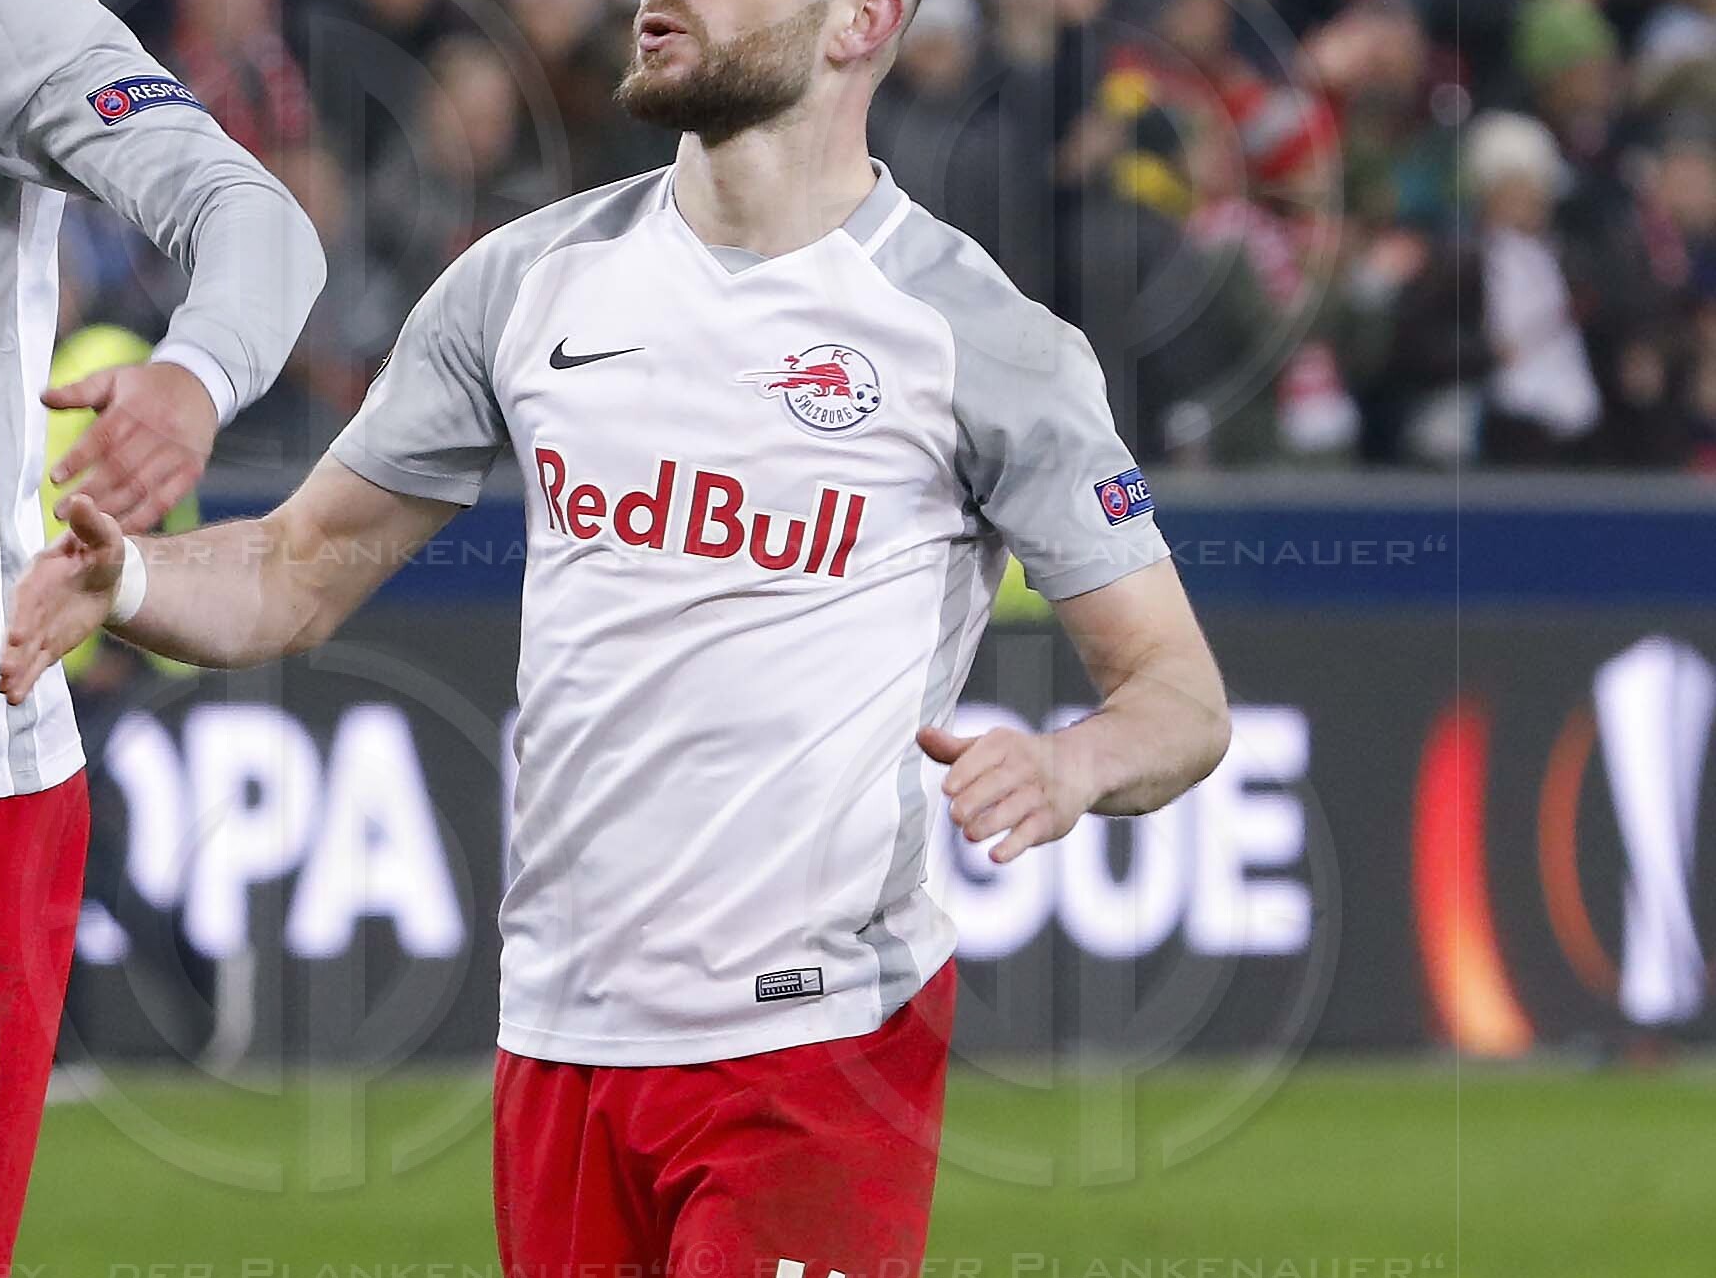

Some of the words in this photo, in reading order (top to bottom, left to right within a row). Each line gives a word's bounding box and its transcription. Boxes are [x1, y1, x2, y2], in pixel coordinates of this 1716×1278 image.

[128, 83, 200, 104] RESPEC
[831, 349, 853, 365] FC
[794, 394, 853, 424] SALZBURG
[535, 447, 677, 550] Red
[683, 470, 866, 578] Bull
